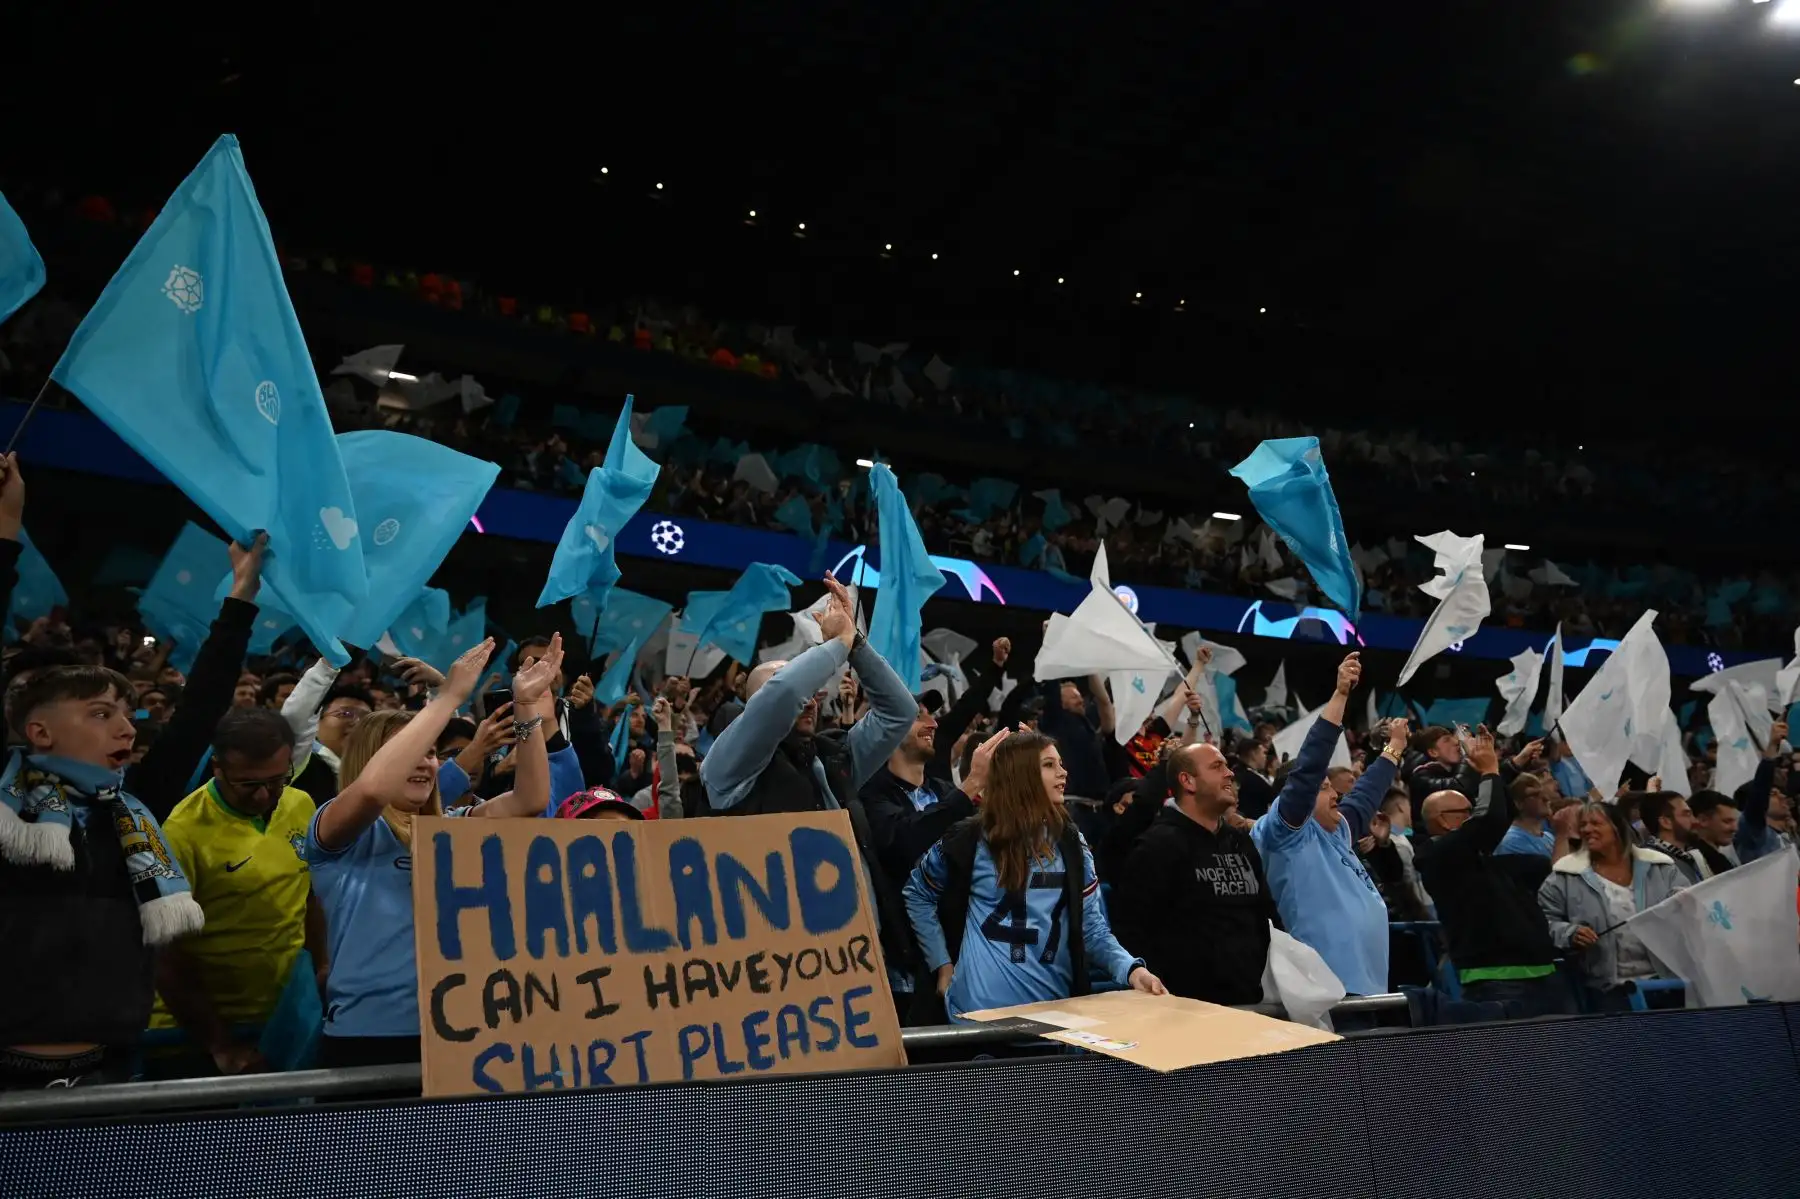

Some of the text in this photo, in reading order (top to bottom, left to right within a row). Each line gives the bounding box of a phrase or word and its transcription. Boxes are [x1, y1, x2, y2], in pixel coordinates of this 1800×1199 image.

[433, 827, 858, 960] HAALAND
[1212, 853, 1237, 868] THE
[1213, 881, 1245, 896] FACE
[981, 871, 1067, 964] 47
[431, 968, 560, 1042] CAN
[576, 966, 621, 1019] I
[472, 985, 879, 1093] SHIRT PLEASE
